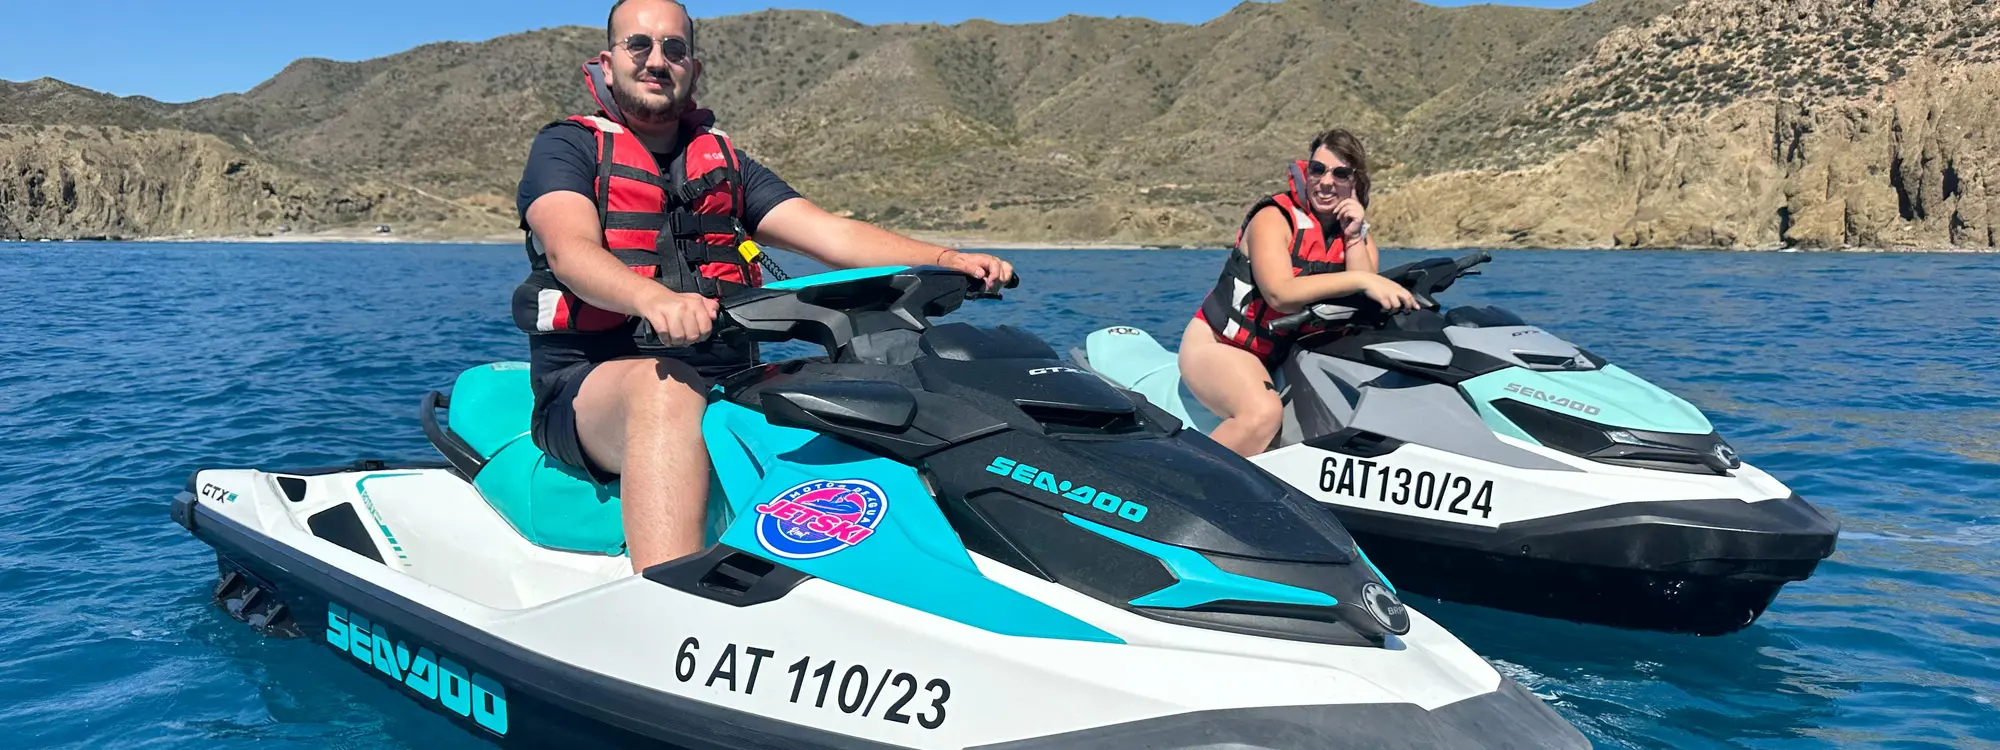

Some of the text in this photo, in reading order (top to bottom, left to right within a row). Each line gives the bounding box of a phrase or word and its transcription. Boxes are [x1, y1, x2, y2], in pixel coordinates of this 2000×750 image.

[1029, 366, 1080, 376] GTX
[202, 483, 230, 504] GTX
[1318, 456, 1495, 520] 6AT130/24
[756, 499, 875, 546] JETSKI
[1387, 606, 1405, 616] BRP
[674, 636, 952, 730] 6 AT 110/23
